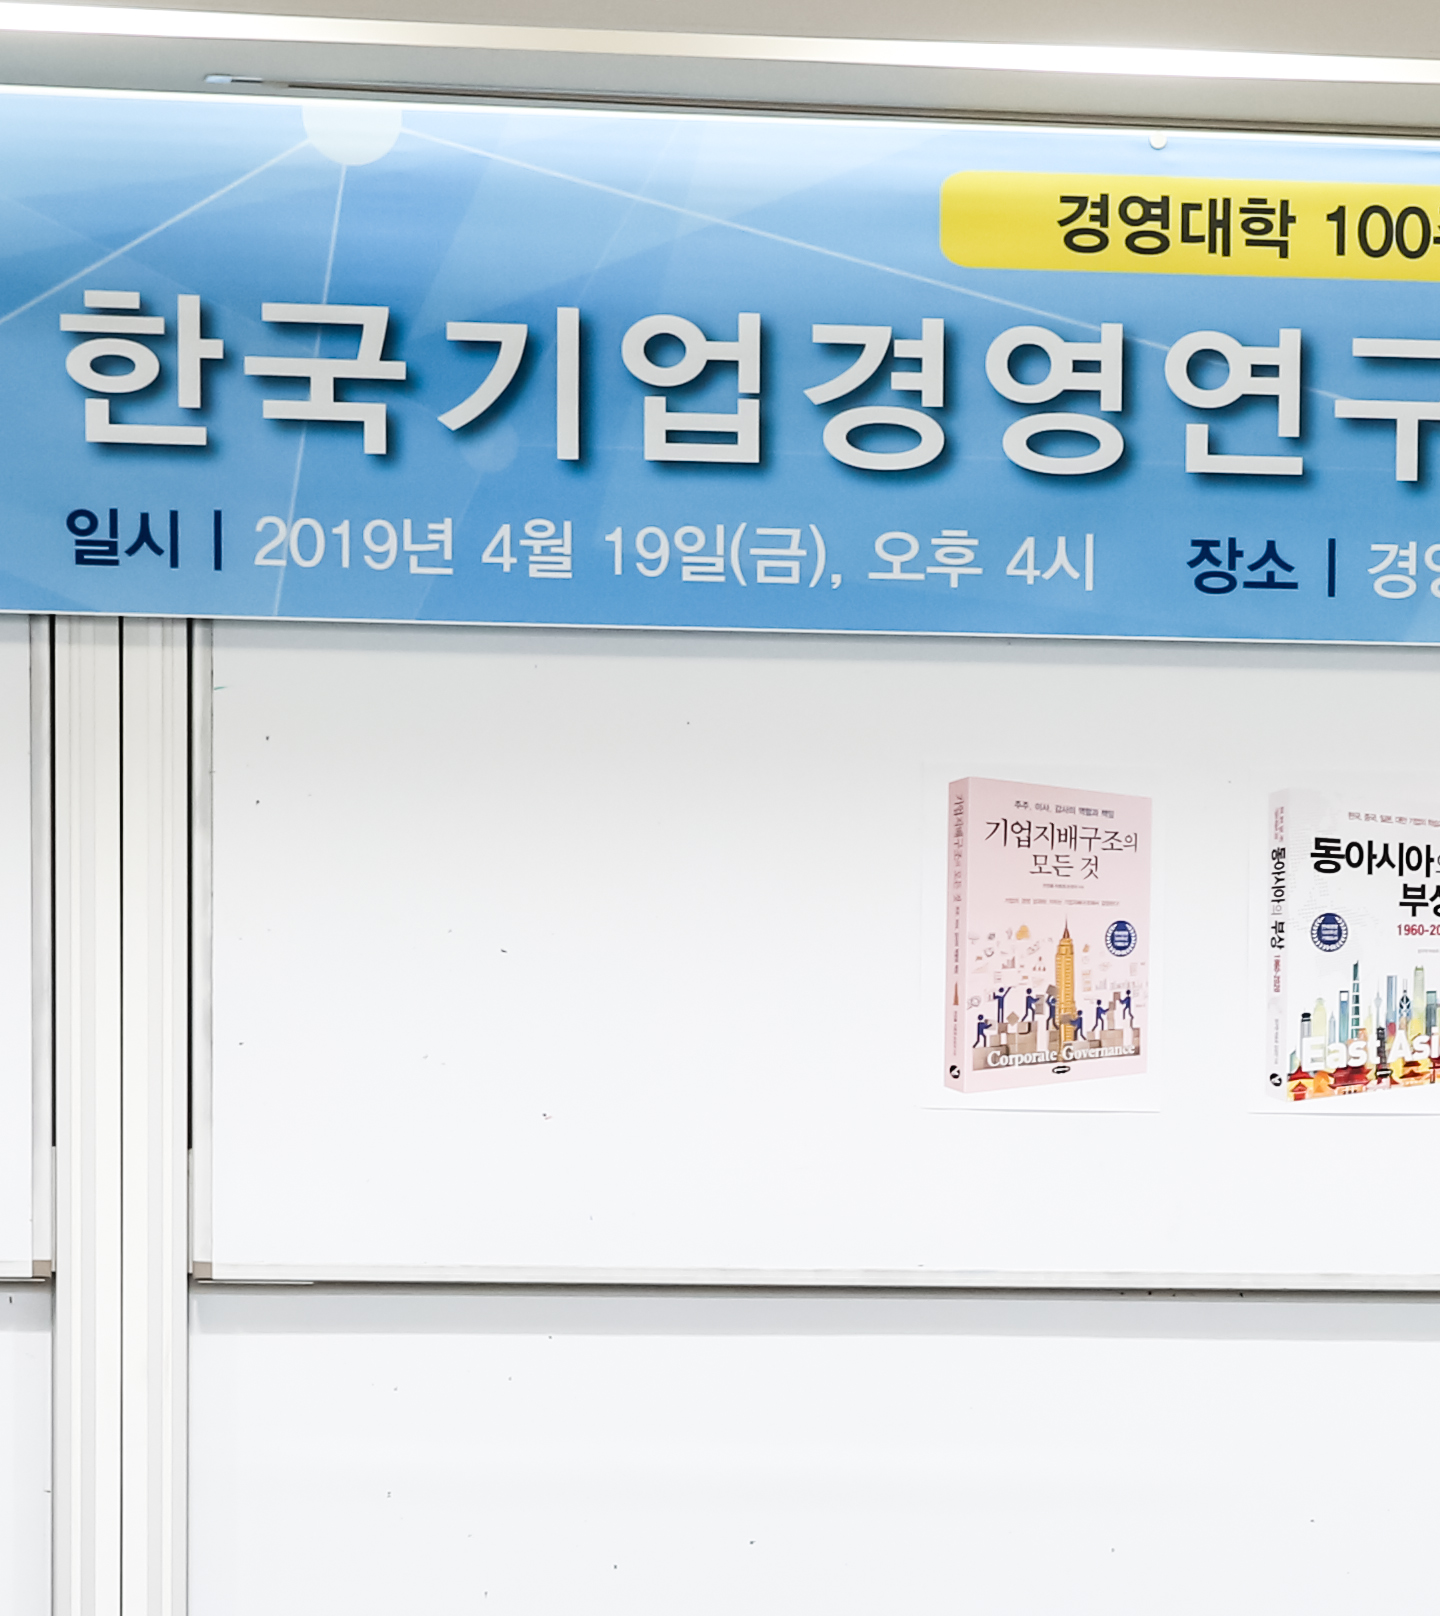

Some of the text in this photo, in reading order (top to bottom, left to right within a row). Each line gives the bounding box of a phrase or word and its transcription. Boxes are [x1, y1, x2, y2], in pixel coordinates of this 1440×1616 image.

[1056, 192, 1296, 260] 경영대학
[65, 508, 181, 569] 일시
[255, 516, 454, 577] 2019년
[482, 518, 574, 579] 4월
[606, 524, 843, 589] 19일(금),
[869, 527, 983, 585] 오후
[1006, 532, 1097, 594] 4시
[1185, 536, 1300, 595] 장소
[985, 818, 1138, 852] 기업지배구조의
[1029, 854, 1099, 880] 모든 것
[987, 1044, 1136, 1067] Corporate Governance
[1301, 1031, 1381, 1072] East
